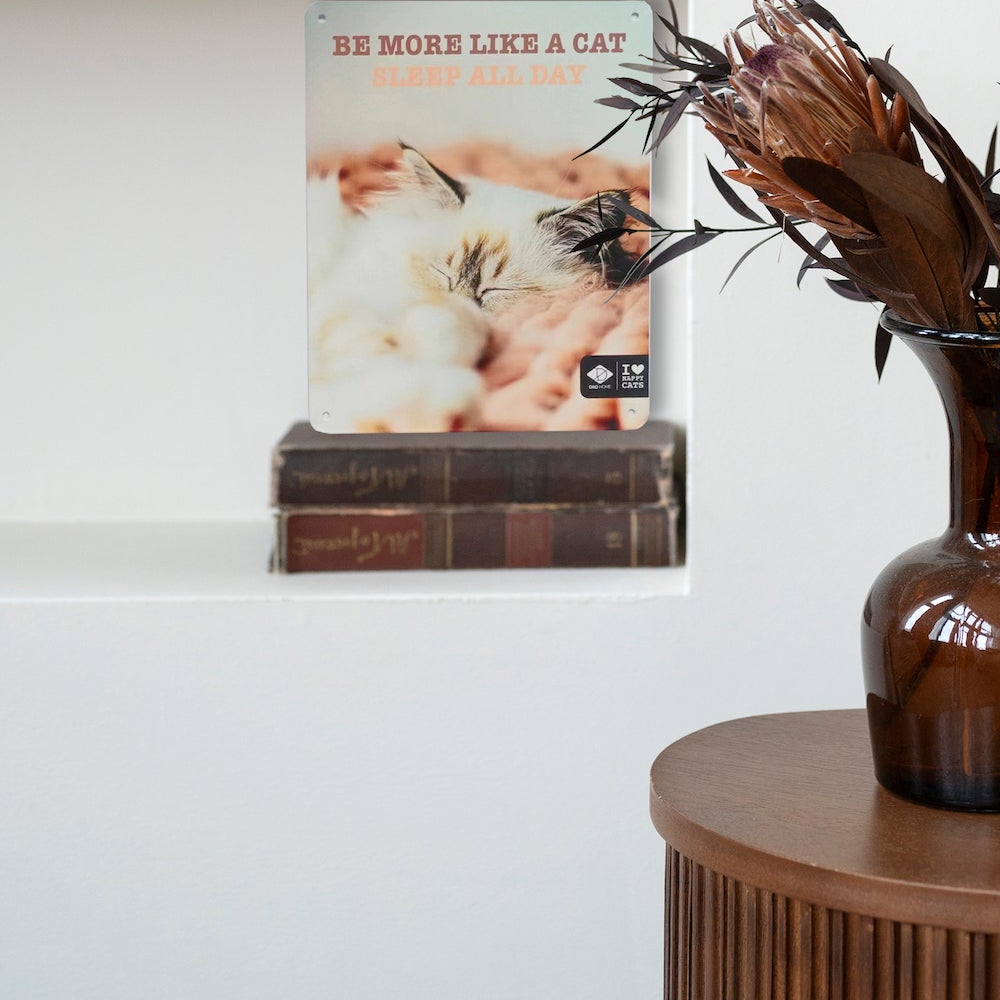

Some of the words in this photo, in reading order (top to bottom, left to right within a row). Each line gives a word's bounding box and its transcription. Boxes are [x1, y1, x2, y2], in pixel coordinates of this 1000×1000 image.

[332, 35, 371, 56] BE
[378, 34, 462, 56] MORE
[469, 33, 538, 55] LIKE
[545, 33, 565, 54] A
[572, 32, 627, 54] CAT
[372, 66, 462, 88] SLEEP
[467, 65, 523, 86] ALL
[529, 64, 586, 85] DAY
[622, 364, 630, 375] I
[621, 381, 644, 389] CATS
